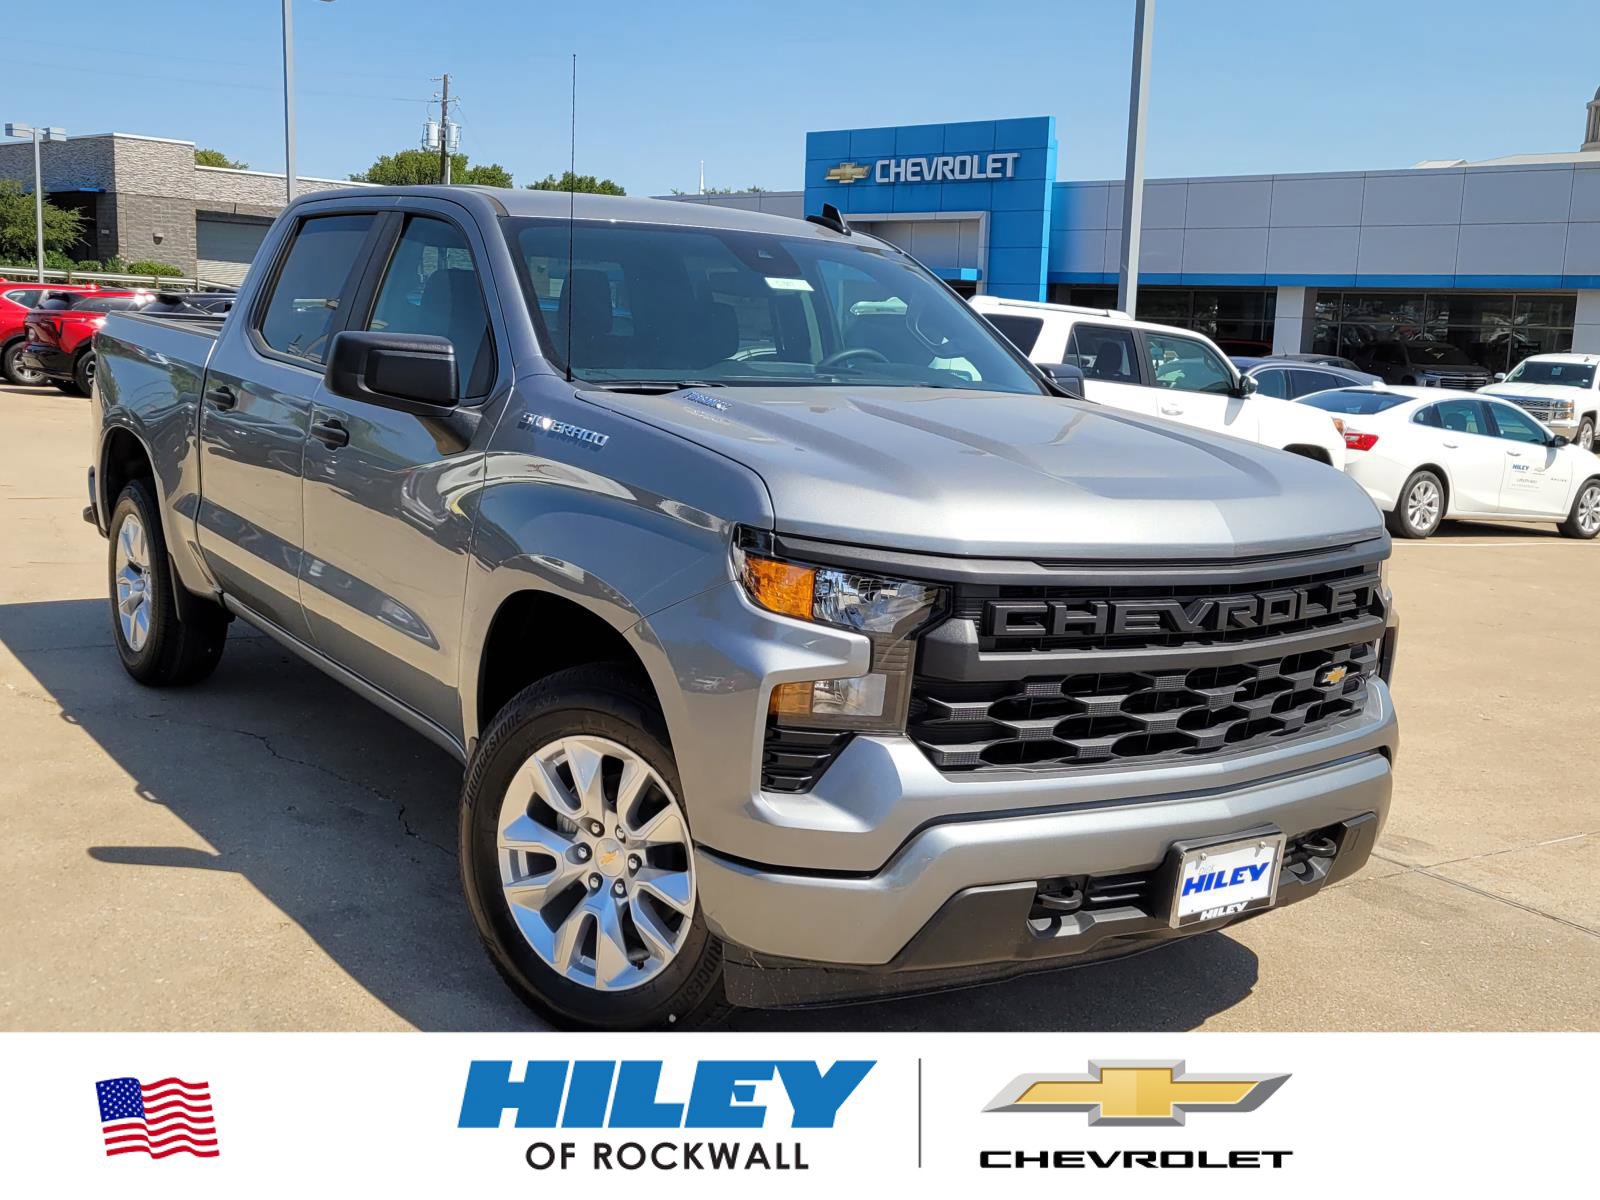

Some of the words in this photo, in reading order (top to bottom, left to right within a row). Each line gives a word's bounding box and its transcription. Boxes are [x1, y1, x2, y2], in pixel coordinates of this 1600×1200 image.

[875, 153, 1021, 184] CHEVROLET
[522, 411, 610, 448] SILVERADO
[991, 576, 1380, 636] CHEVROLET
[1182, 862, 1270, 896] HILEY
[1200, 901, 1249, 920] HILEY
